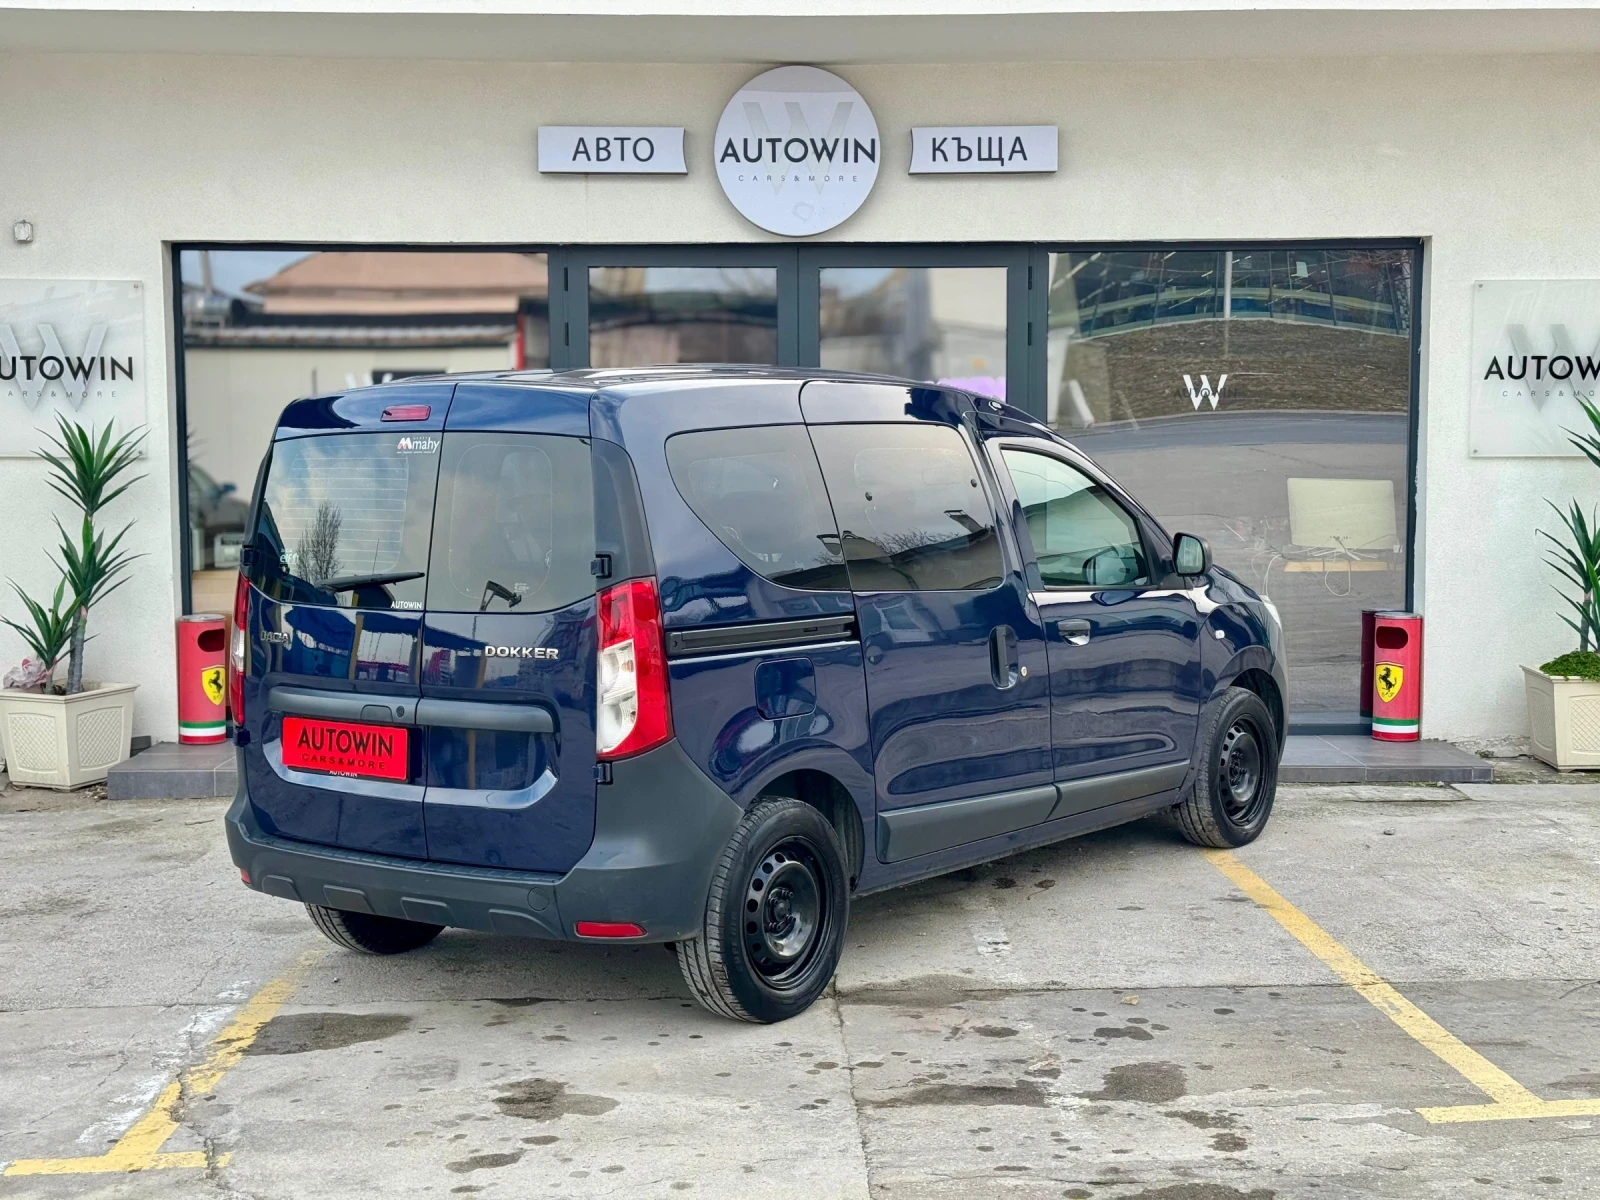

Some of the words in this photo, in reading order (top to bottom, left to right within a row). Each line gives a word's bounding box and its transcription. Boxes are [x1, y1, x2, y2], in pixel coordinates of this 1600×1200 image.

[572, 137, 655, 162] АВТО
[720, 138, 875, 163] AUTOWIN
[932, 136, 1028, 167] КЪЩА
[0, 355, 133, 381] UTOWIN
[1483, 355, 1600, 381] AUTOW
[8, 390, 117, 398] ARS&MORE
[1502, 390, 1595, 398] CARS&MO
[390, 600, 422, 609] AUTOWIN
[484, 645, 559, 660] DOKKER
[298, 726, 393, 759] AUTOWIN
[302, 753, 385, 770] CARS&MORE
